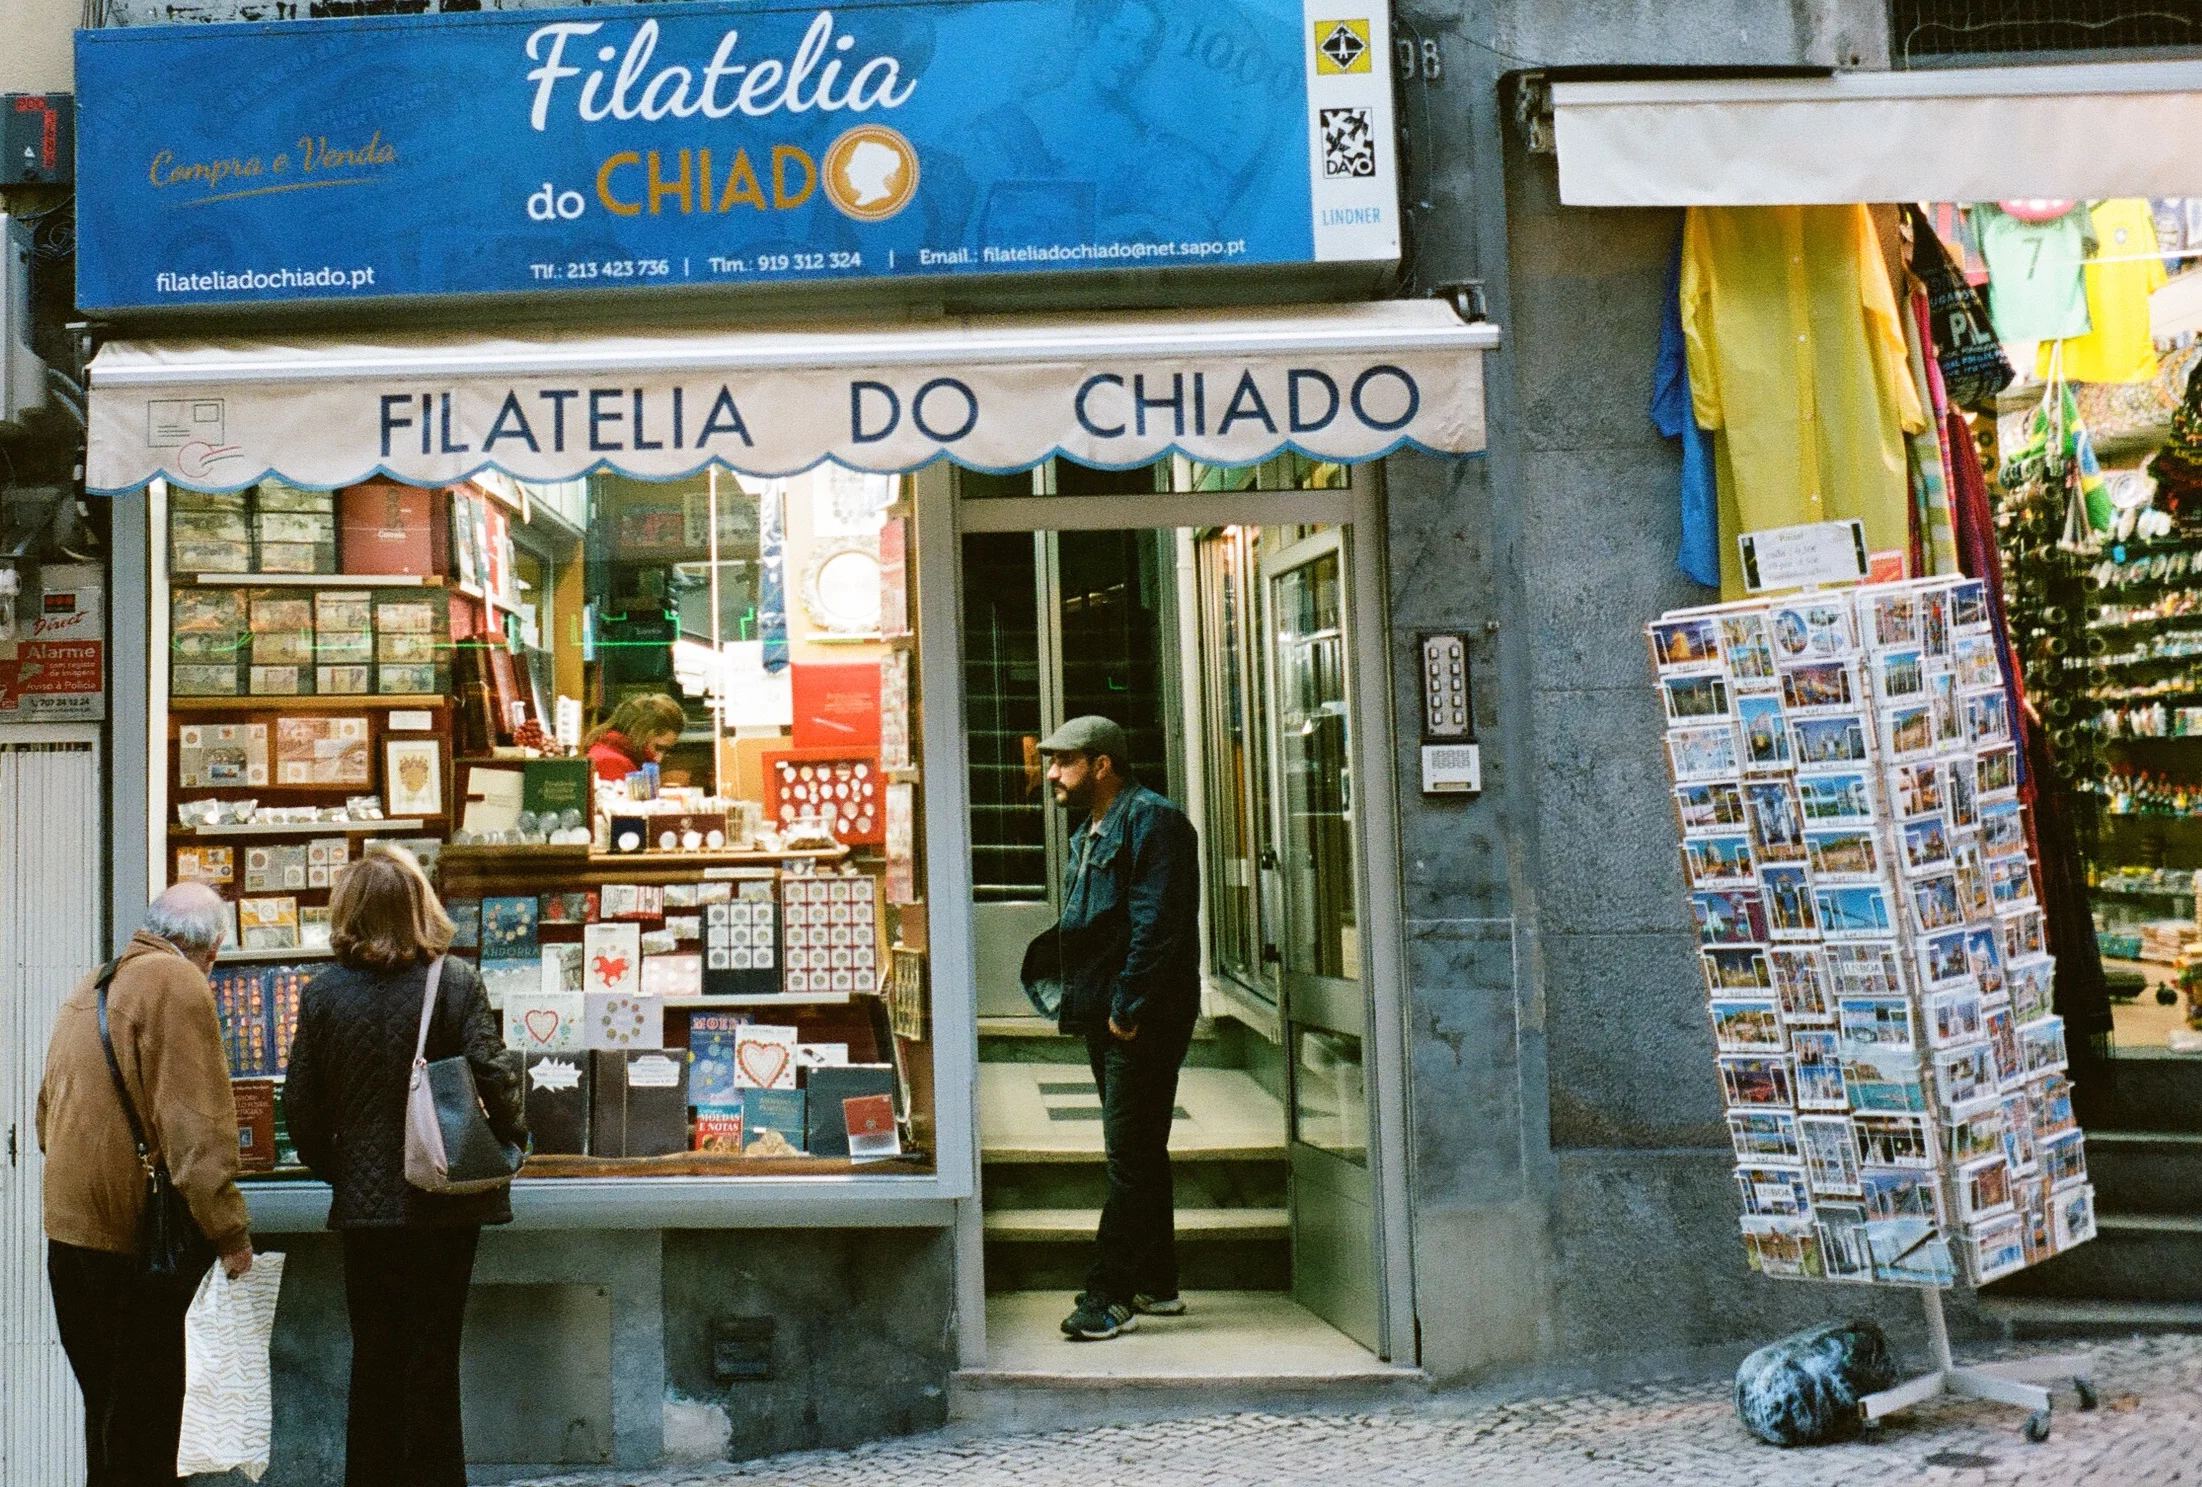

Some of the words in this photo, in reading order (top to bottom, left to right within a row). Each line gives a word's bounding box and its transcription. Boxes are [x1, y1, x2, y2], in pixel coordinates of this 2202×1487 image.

[526, 10, 917, 131] Filatelia
[149, 149, 265, 188] Compra
[272, 153, 289, 175] e
[297, 130, 398, 172] Venda
[1326, 157, 1373, 176] DAVO
[527, 183, 586, 221] do
[1321, 208, 1381, 226] LINDNER
[567, 263, 598, 278] 213
[601, 261, 634, 277] 423
[637, 260, 669, 276] 736
[758, 256, 789, 271] 919
[793, 254, 825, 270] 312
[829, 252, 862, 268] 324
[983, 239, 1246, 263] filateliadochiado@net.sapo.pt
[2021, 237, 2044, 280] 7
[156, 267, 375, 292] filateliadochiado.pt
[380, 384, 755, 457] FILATELIA
[851, 377, 979, 443] DO
[1074, 364, 1420, 438] CHIADO
[32, 610, 89, 636] Direct
[25, 643, 96, 659] Alarme
[700, 1113, 740, 1121] MOEDAS
[707, 1121, 739, 1131] NOTAS
